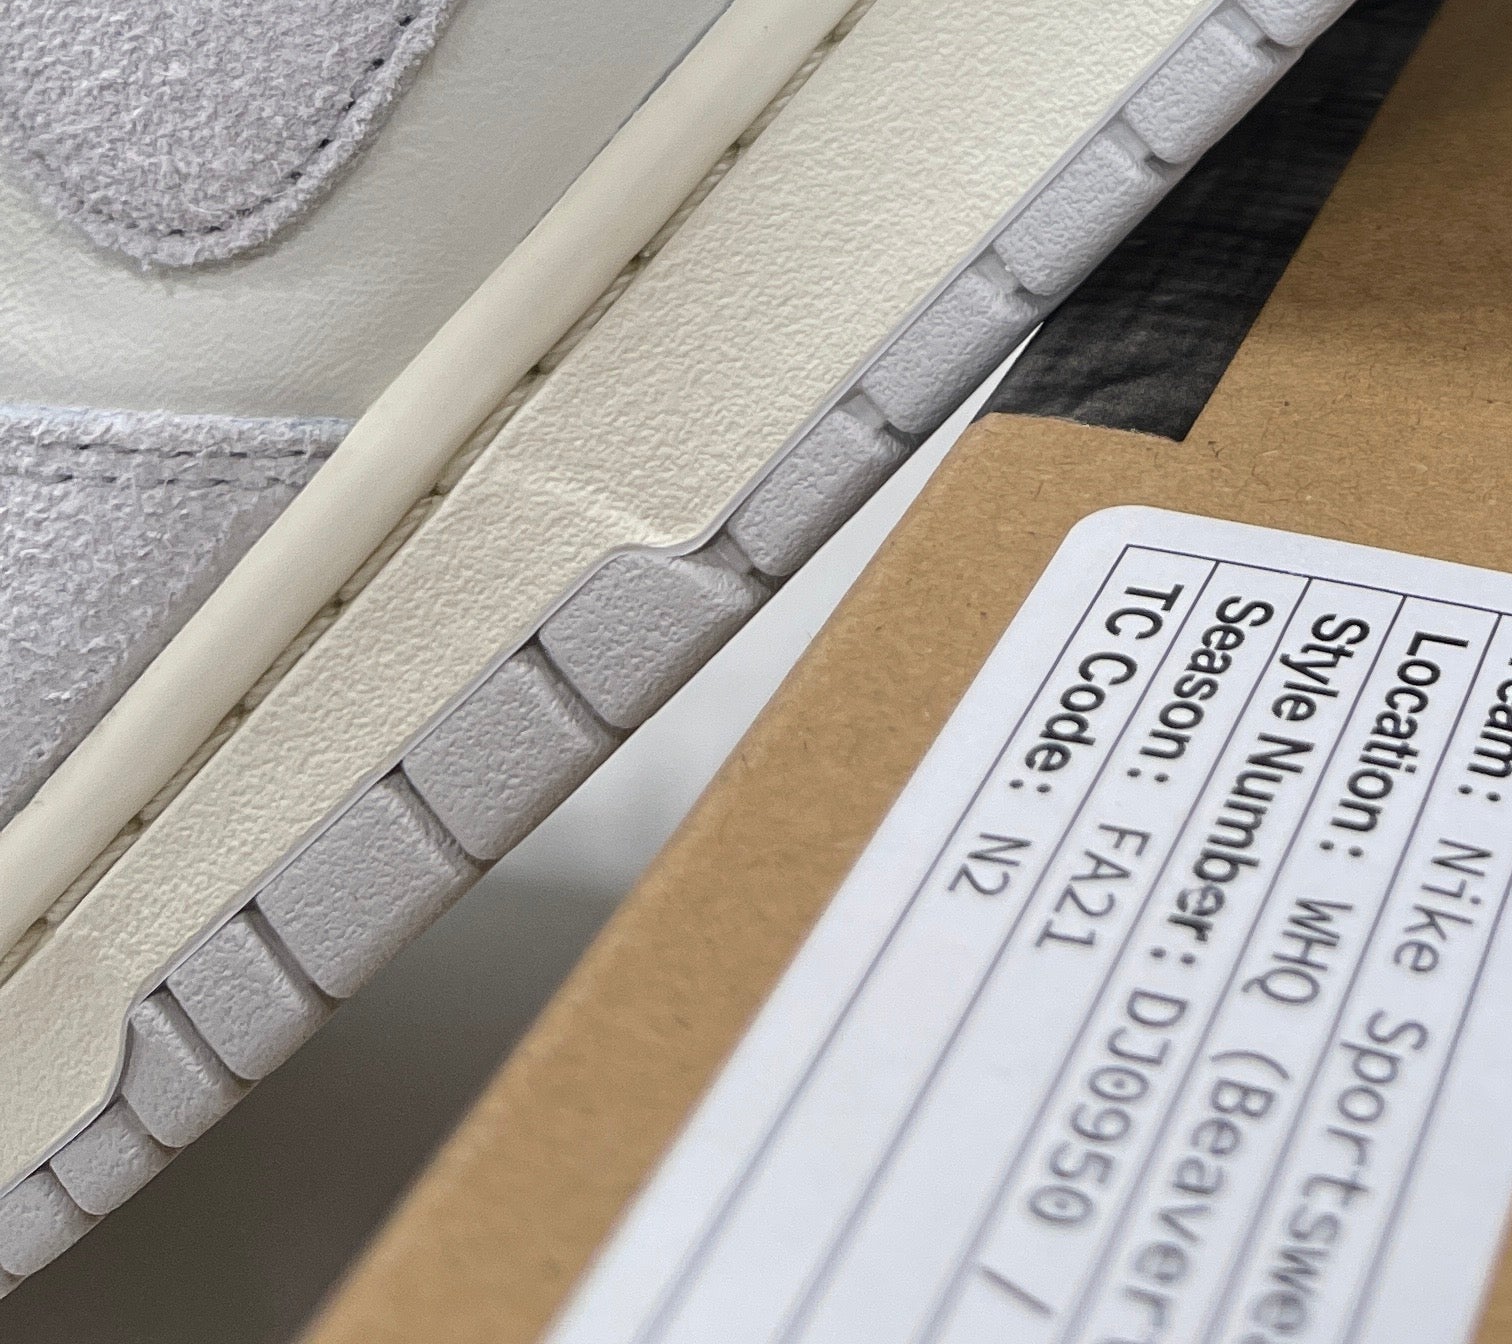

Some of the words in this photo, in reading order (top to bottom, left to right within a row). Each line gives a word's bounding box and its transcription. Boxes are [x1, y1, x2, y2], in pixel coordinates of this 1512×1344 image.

[1103, 582, 1185, 641] TC
[1279, 612, 1371, 723] Style
[1009, 650, 1139, 796] Code:
[1126, 594, 1276, 784] Season:
[1319, 629, 1470, 859] Location:
[946, 831, 1033, 898] N2
[1034, 822, 1153, 950] FA21
[1149, 731, 1316, 966] Number:
[1392, 837, 1495, 974] Nike
[1241, 896, 1354, 1006] WHQ
[1027, 986, 1189, 1227] DJ0950
[1240, 1010, 1430, 1344] Sportswe
[1098, 1048, 1291, 1344] (Beaver
